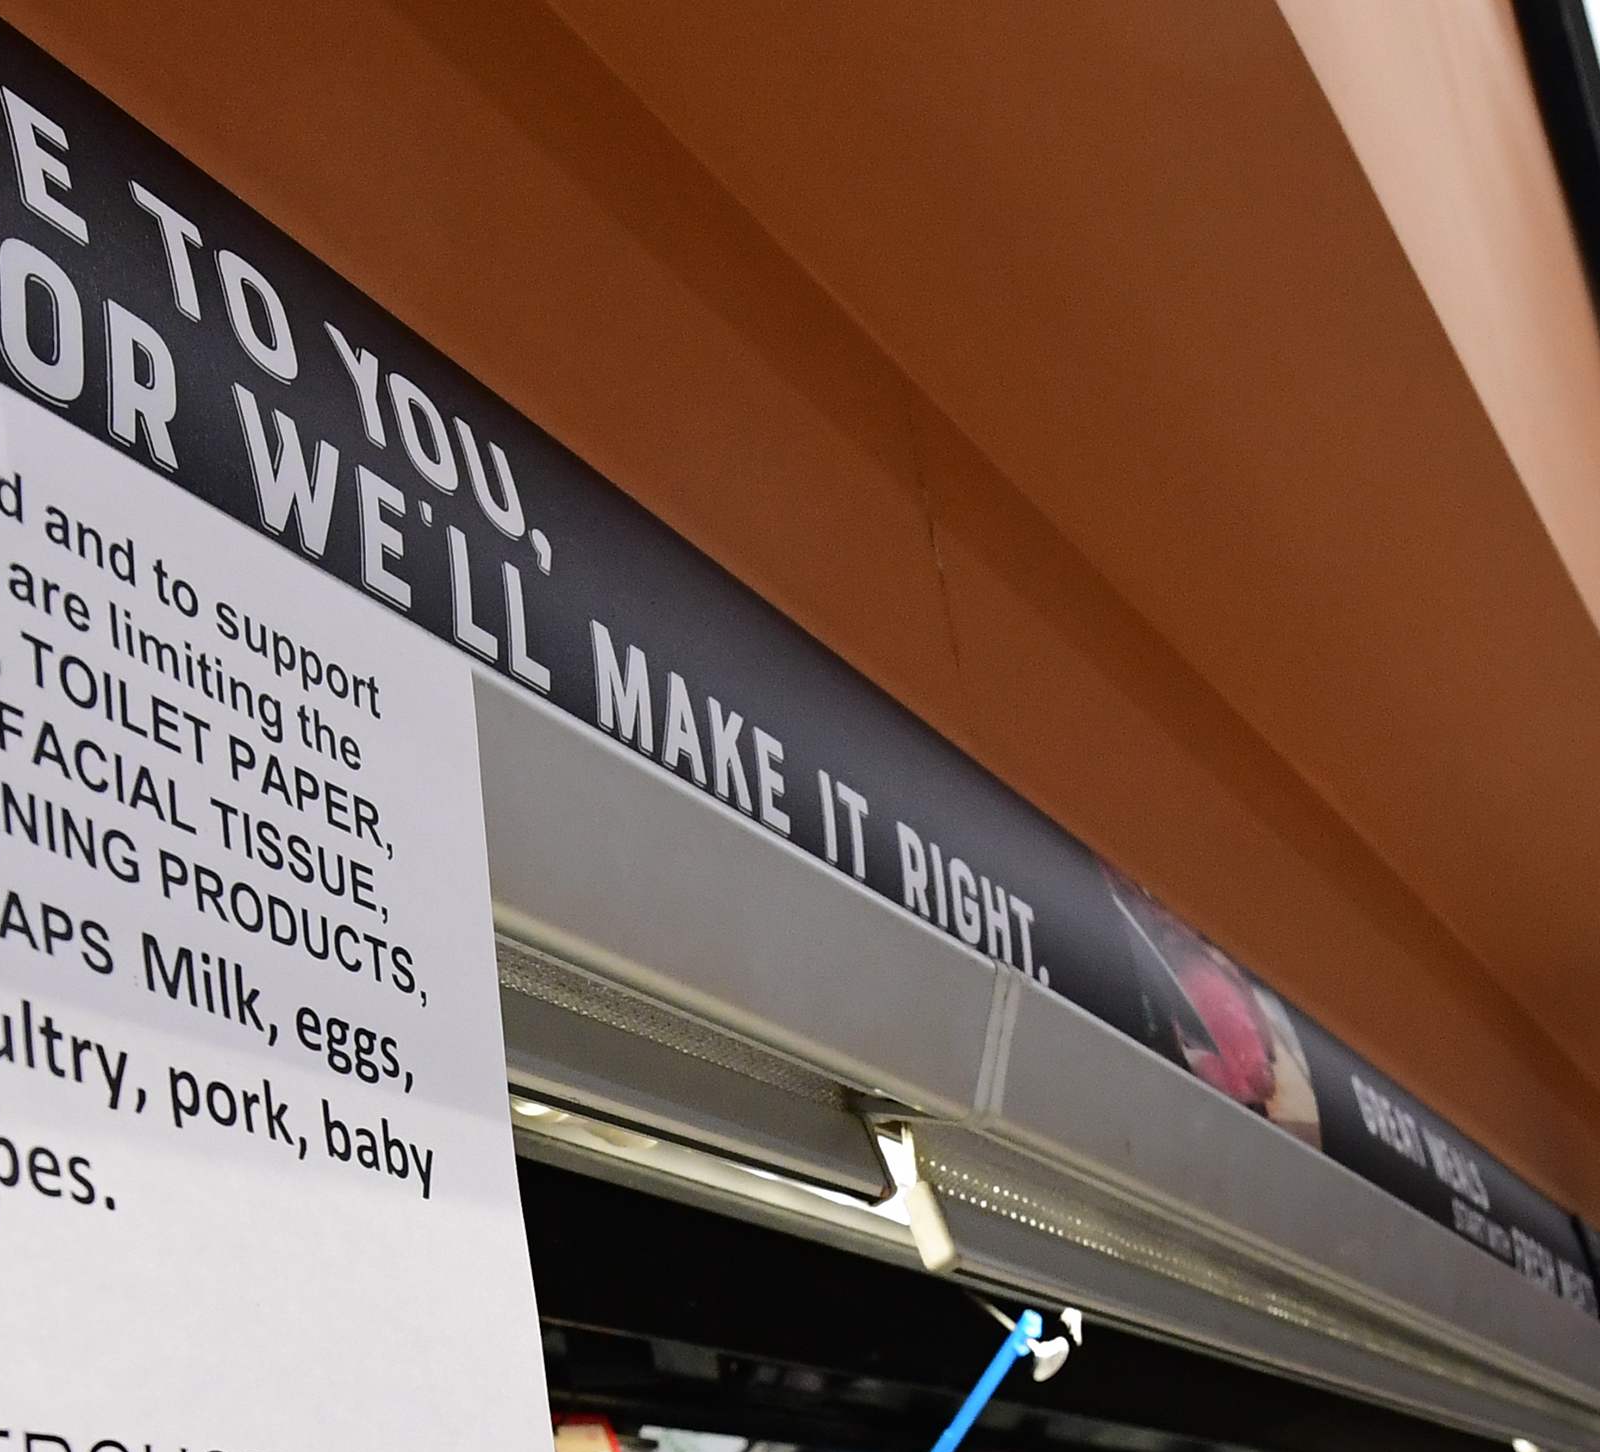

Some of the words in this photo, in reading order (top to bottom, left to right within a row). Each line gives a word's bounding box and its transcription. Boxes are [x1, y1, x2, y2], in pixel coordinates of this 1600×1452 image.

[130, 180, 298, 384] TO
[325, 320, 553, 578] YOU,
[8, 558, 91, 632] are
[108, 601, 284, 744] limiting
[298, 703, 363, 771] the
[44, 506, 135, 588] and
[153, 557, 200, 618] to
[215, 605, 382, 719] support
[231, 383, 553, 694] WE'LL
[589, 619, 792, 838] MAKE
[817, 769, 869, 880] IT
[897, 820, 1051, 986] RIGHT.
[19, 631, 210, 764] TOILET
[230, 734, 394, 860] PAPER,
[161, 848, 427, 1006] PRODUCTS,
[211, 797, 389, 922] TISSUE,
[141, 932, 280, 1047] Milk,
[296, 1003, 415, 1094] eggs,
[169, 1066, 308, 1159] pork,
[322, 1098, 434, 1200] baby
